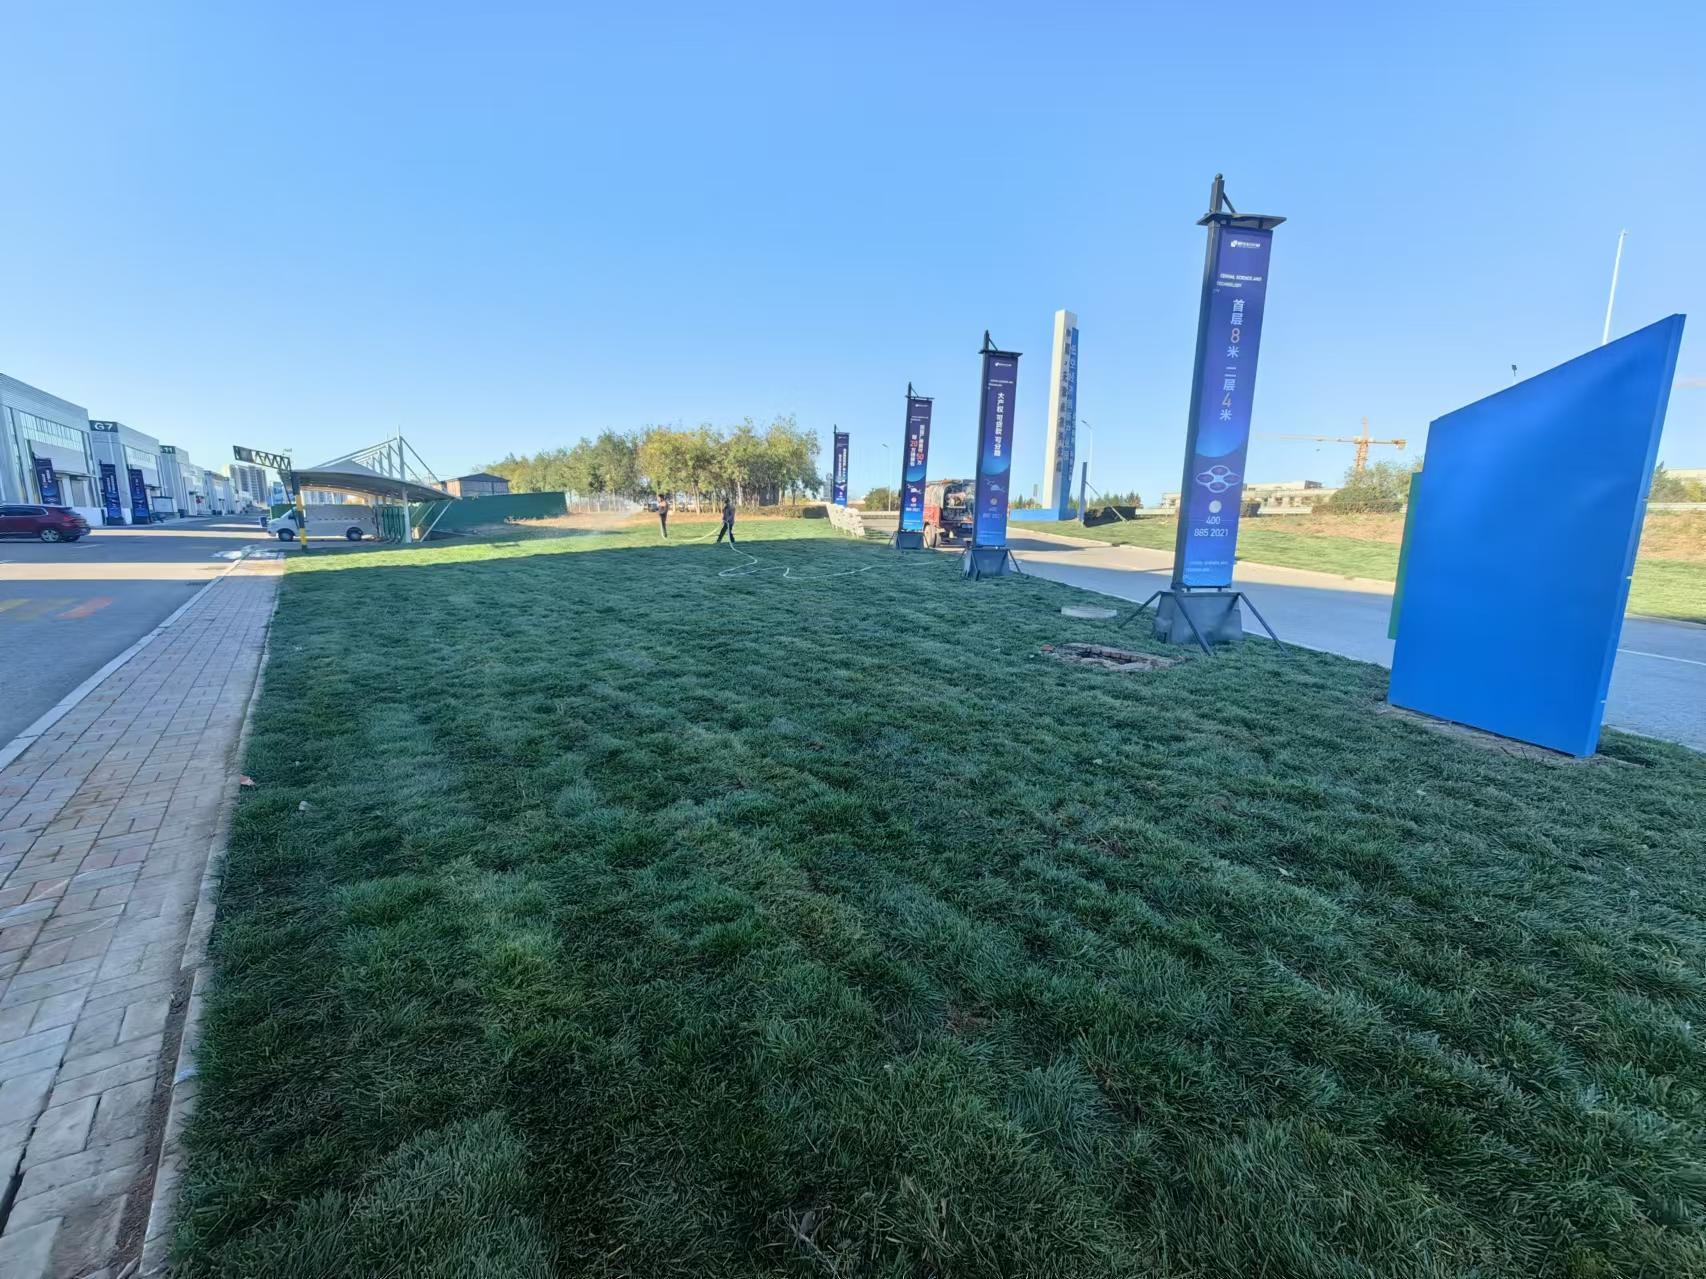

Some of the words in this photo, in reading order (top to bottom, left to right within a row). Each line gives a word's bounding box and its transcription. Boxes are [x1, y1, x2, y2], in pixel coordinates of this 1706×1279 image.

[1227, 299, 1245, 358] 首层8米
[1219, 366, 1237, 421] 二层4米
[94, 422, 113, 431] G7
[1206, 516, 1220, 524] 400
[1210, 528, 1229, 537] 2021
